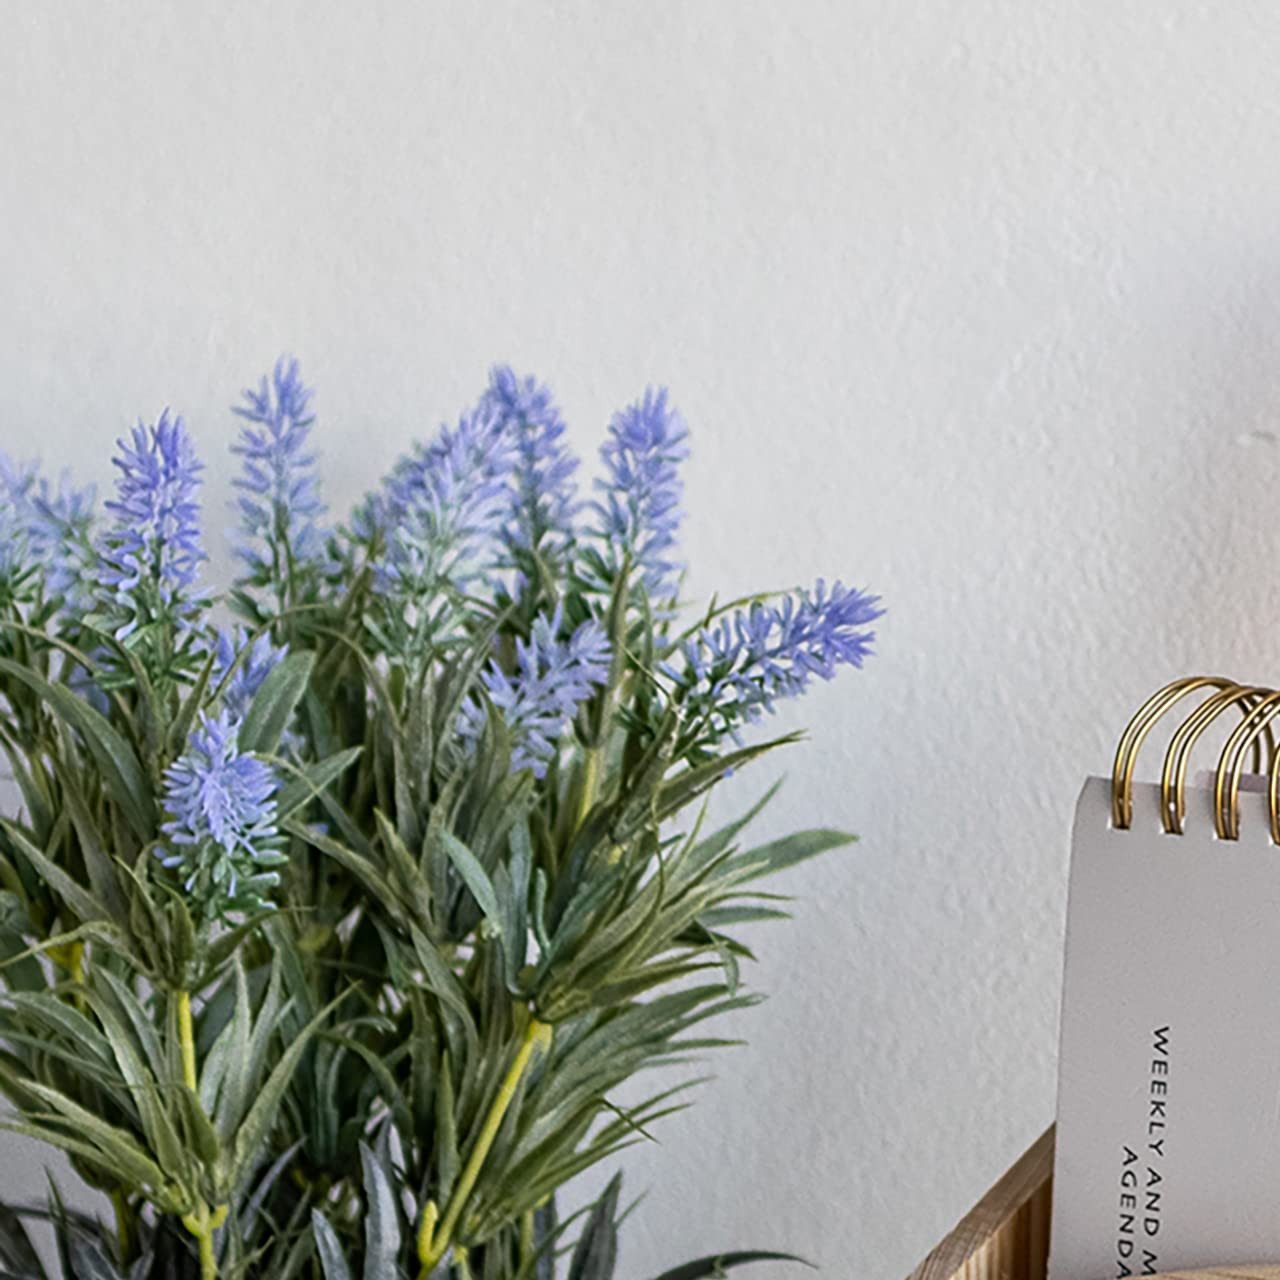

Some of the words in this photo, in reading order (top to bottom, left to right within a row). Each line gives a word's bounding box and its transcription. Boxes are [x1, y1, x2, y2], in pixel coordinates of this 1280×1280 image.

[1147, 1025, 1171, 1158] WEEKLY
[1116, 1146, 1139, 1280] AGENDA
[1143, 1166, 1163, 1237] AND
